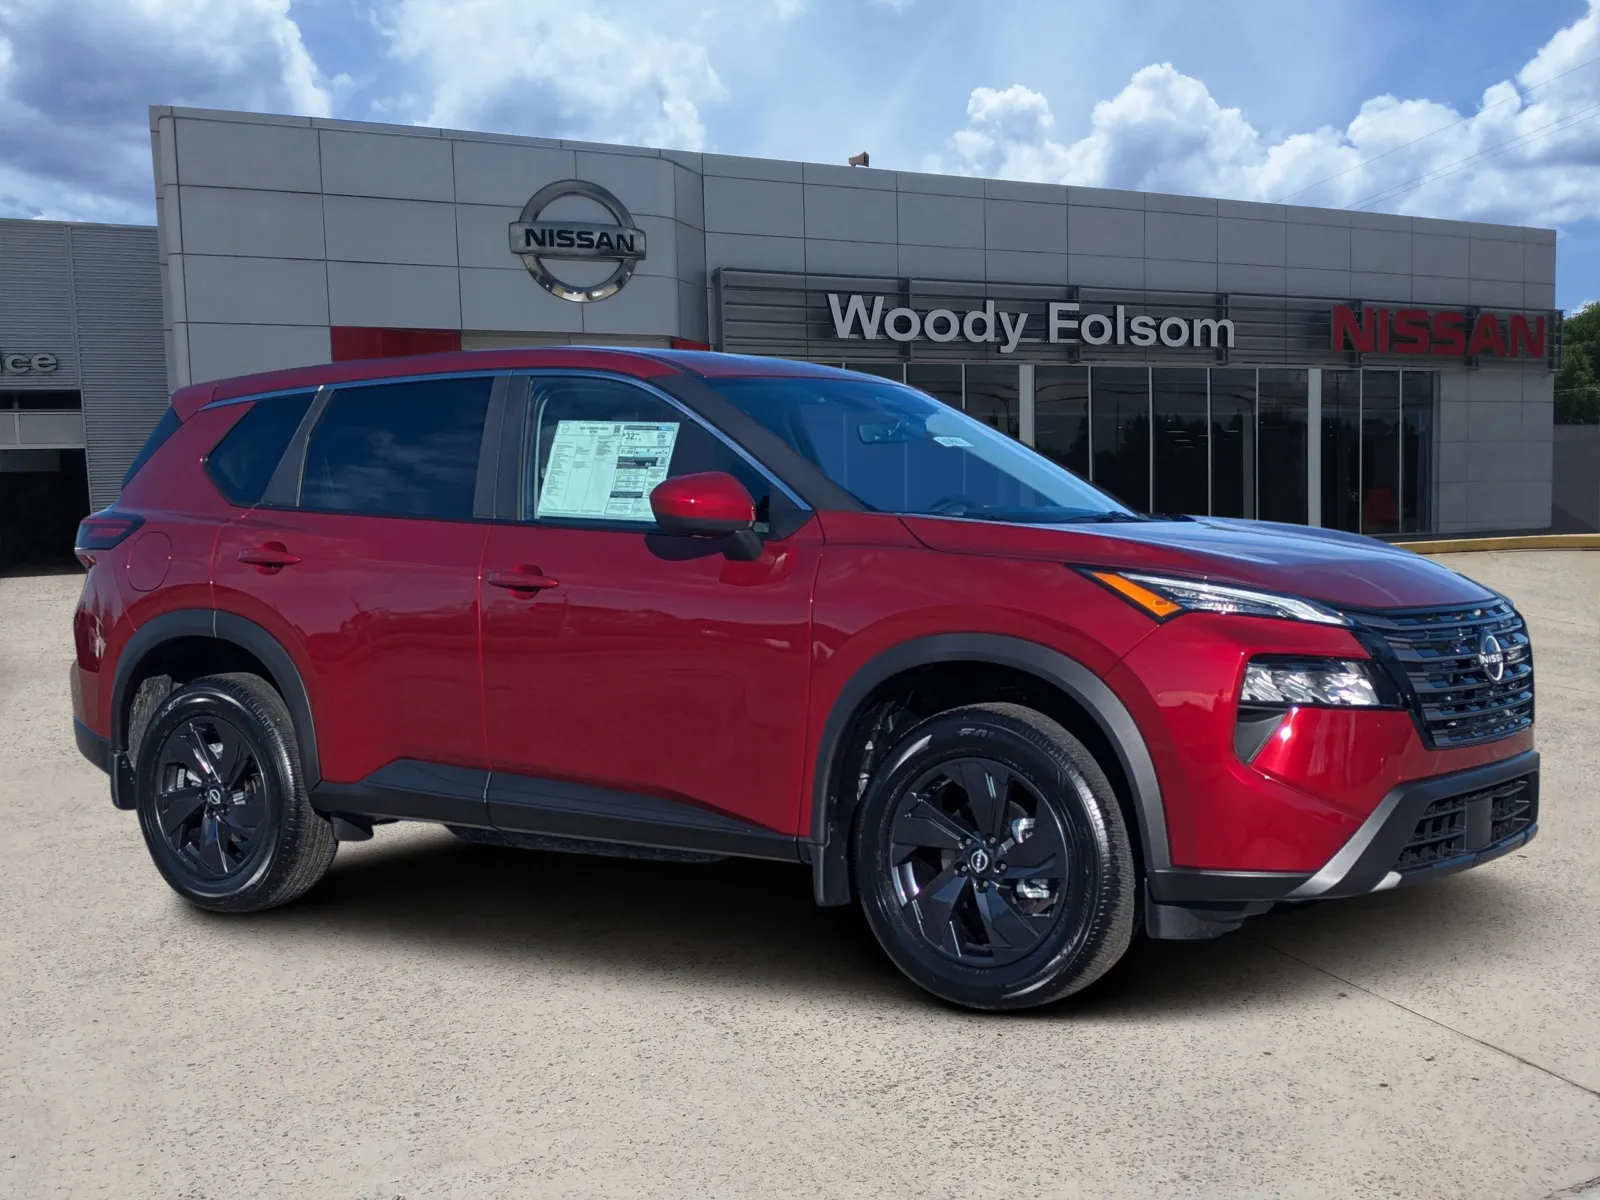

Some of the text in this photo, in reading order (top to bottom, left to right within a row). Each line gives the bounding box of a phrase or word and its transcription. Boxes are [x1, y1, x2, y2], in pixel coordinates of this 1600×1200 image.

[524, 228, 635, 252] NISSAN
[827, 293, 1236, 354] Woody Folsom
[1332, 305, 1545, 358] NISSAN
[0, 352, 58, 374] ce
[1481, 654, 1503, 663] NISS
